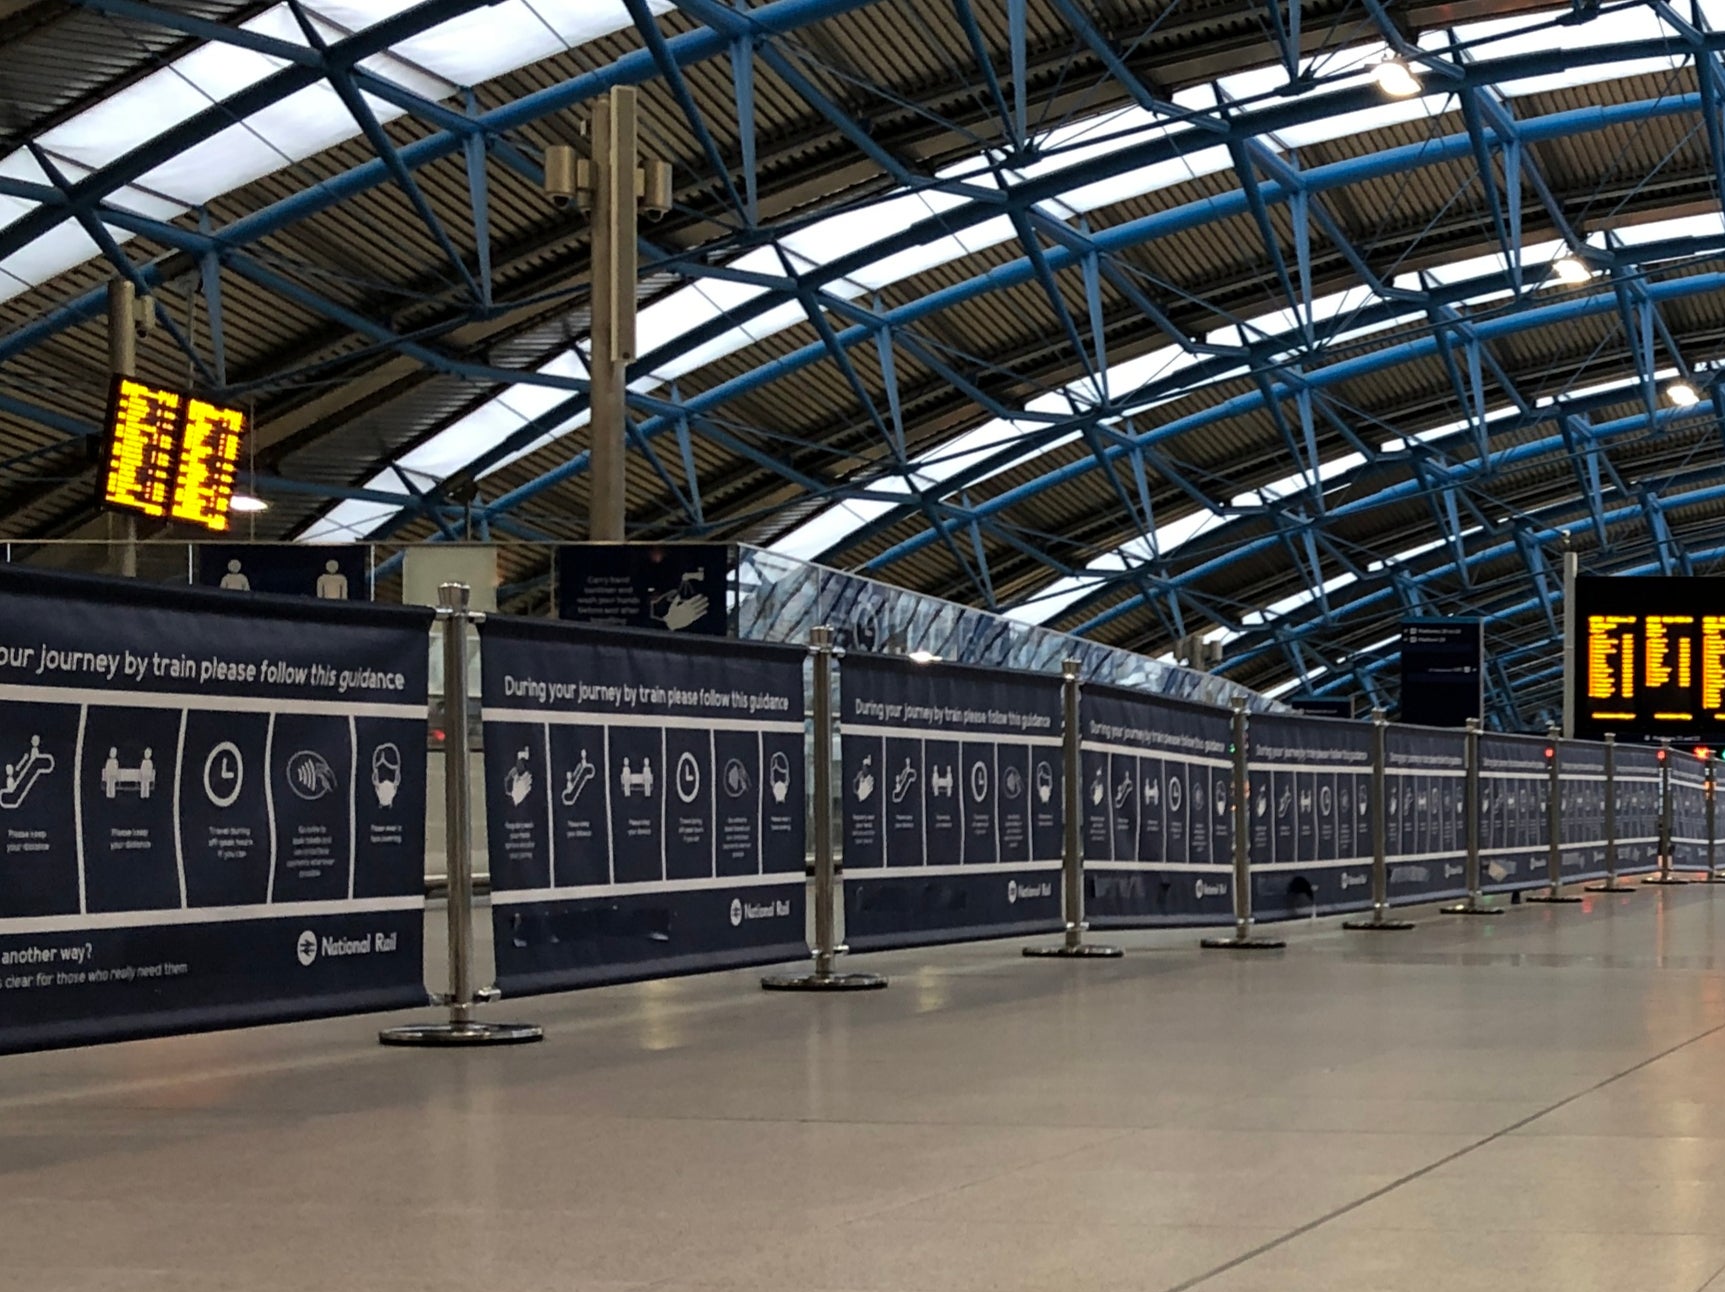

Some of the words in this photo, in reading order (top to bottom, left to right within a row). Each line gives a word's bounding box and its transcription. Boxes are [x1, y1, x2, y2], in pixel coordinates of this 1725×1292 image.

[35, 643, 120, 681] journey
[124, 650, 149, 682] by
[152, 652, 197, 679] train
[200, 655, 257, 683] please
[260, 659, 308, 685] follow
[309, 664, 338, 686] this
[338, 667, 406, 693] guidance
[504, 675, 547, 703] During
[548, 682, 577, 704] your
[578, 681, 622, 707] journey
[624, 683, 637, 708] by
[639, 684, 666, 704] train
[667, 686, 699, 708] please
[700, 688, 731, 707] follow
[731, 690, 749, 709] this
[750, 691, 789, 714] guidance
[855, 698, 884, 720] During
[885, 704, 903, 721] your
[903, 702, 934, 724] journey
[934, 705, 944, 725] by
[944, 706, 963, 722] train
[963, 707, 987, 726] please
[1022, 711, 1051, 730] guidance
[1018, 882, 1041, 898] National
[744, 901, 775, 919] National
[776, 899, 791, 916] Rail
[1, 946, 57, 965] another
[60, 943, 93, 965] way?
[321, 936, 371, 956] National
[375, 932, 397, 952] Rail
[5, 974, 34, 989] clear
[36, 972, 54, 987] for
[56, 971, 86, 985] those
[87, 968, 109, 982] who
[109, 965, 136, 982] really
[136, 963, 162, 977] need
[163, 962, 188, 975] them
